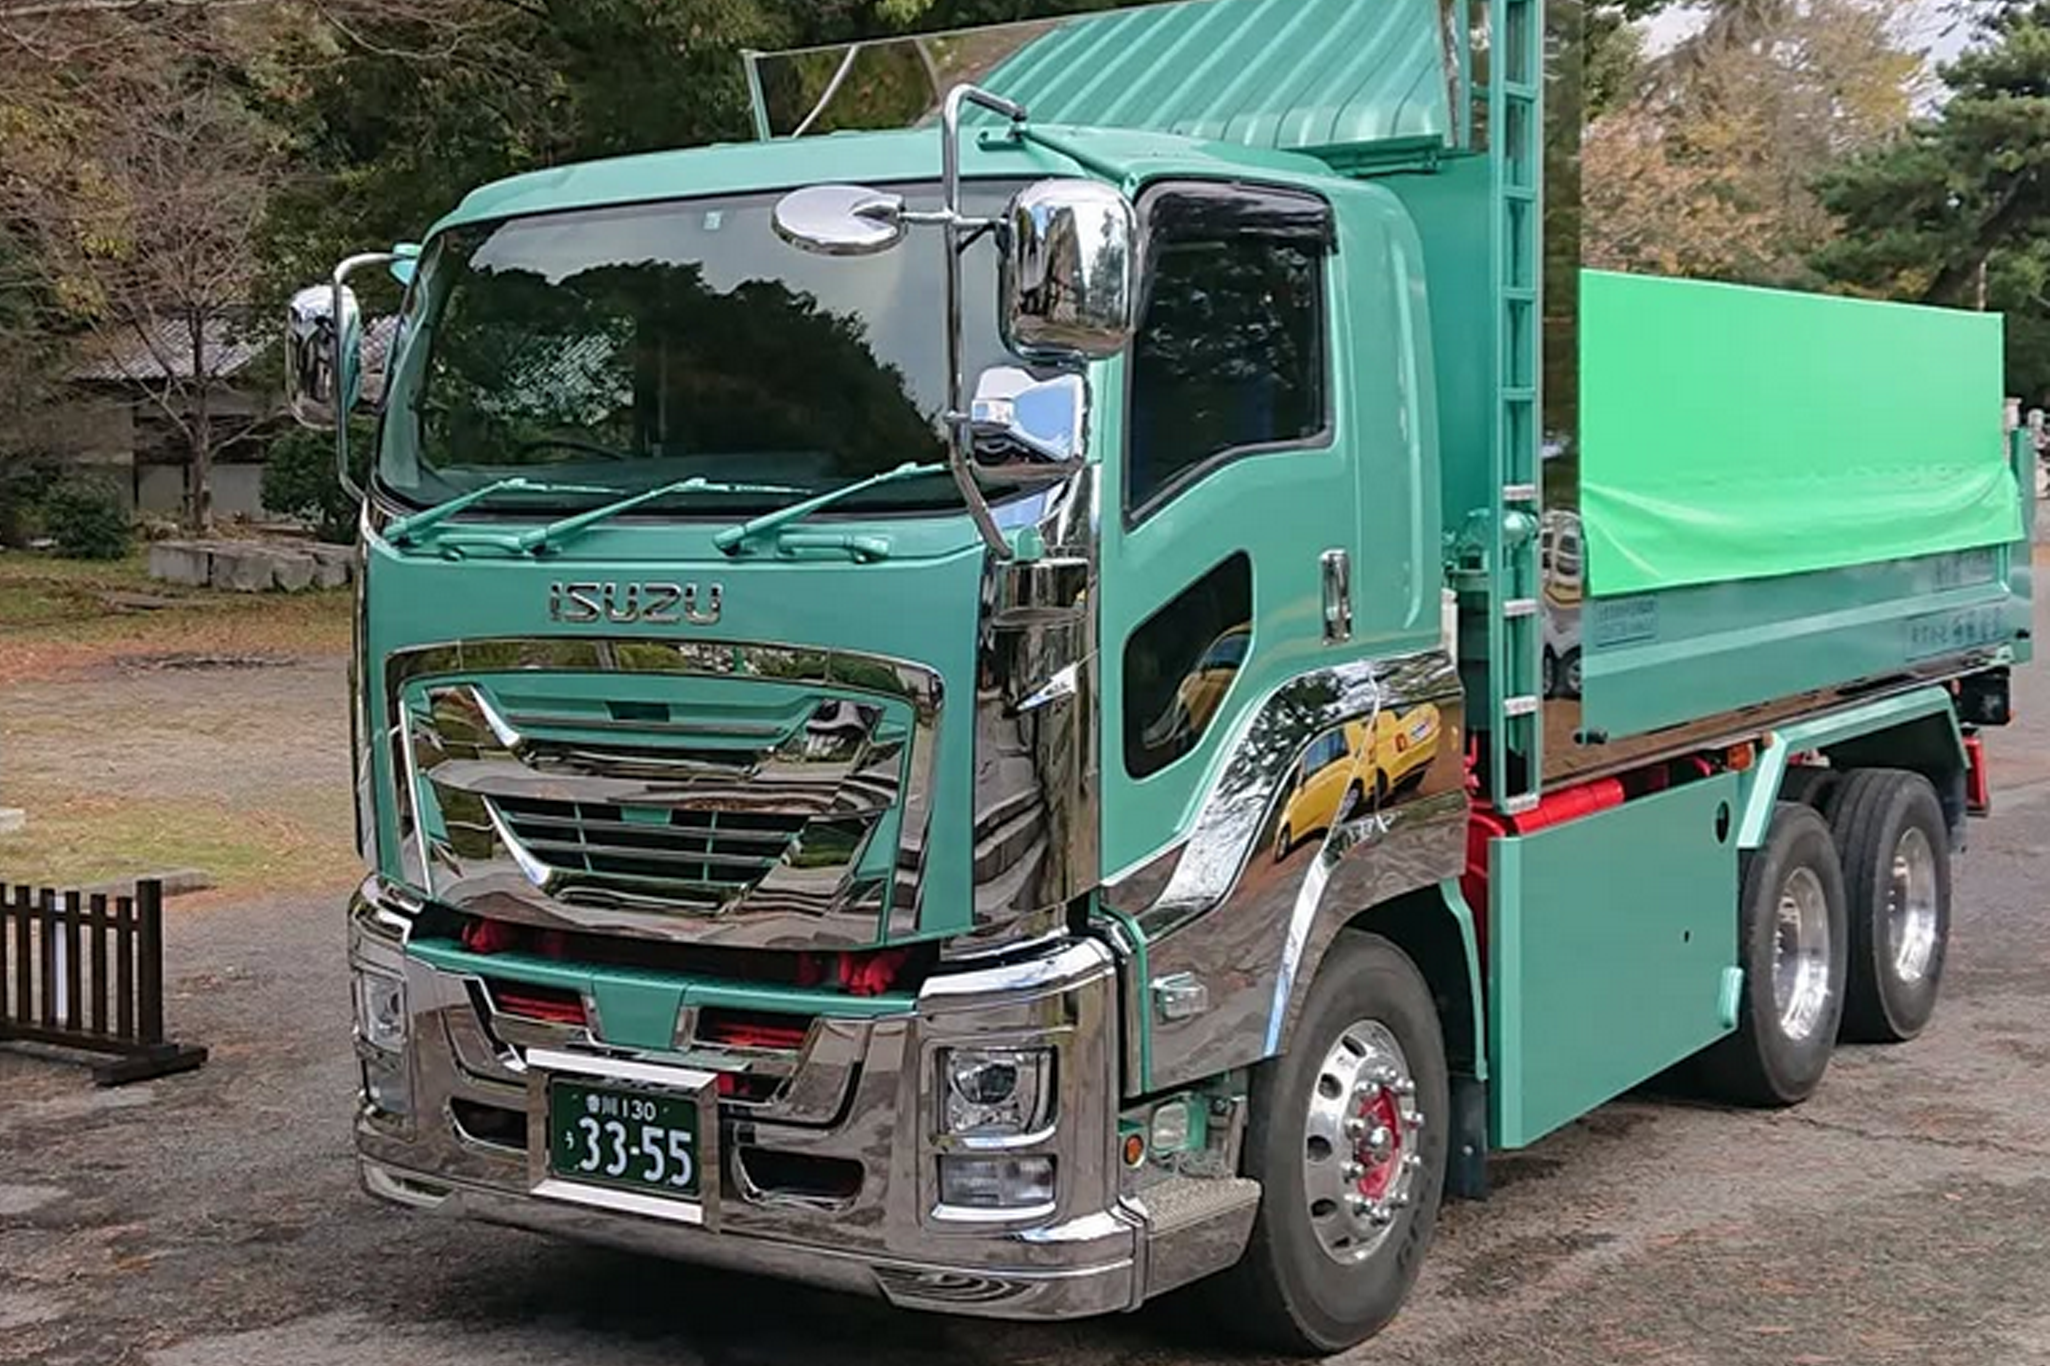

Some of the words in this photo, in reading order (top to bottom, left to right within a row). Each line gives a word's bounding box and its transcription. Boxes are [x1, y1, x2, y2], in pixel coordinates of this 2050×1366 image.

[550, 582, 723, 625] ISUZU
[622, 1098, 657, 1122] 130
[578, 1117, 692, 1187] 33-55
